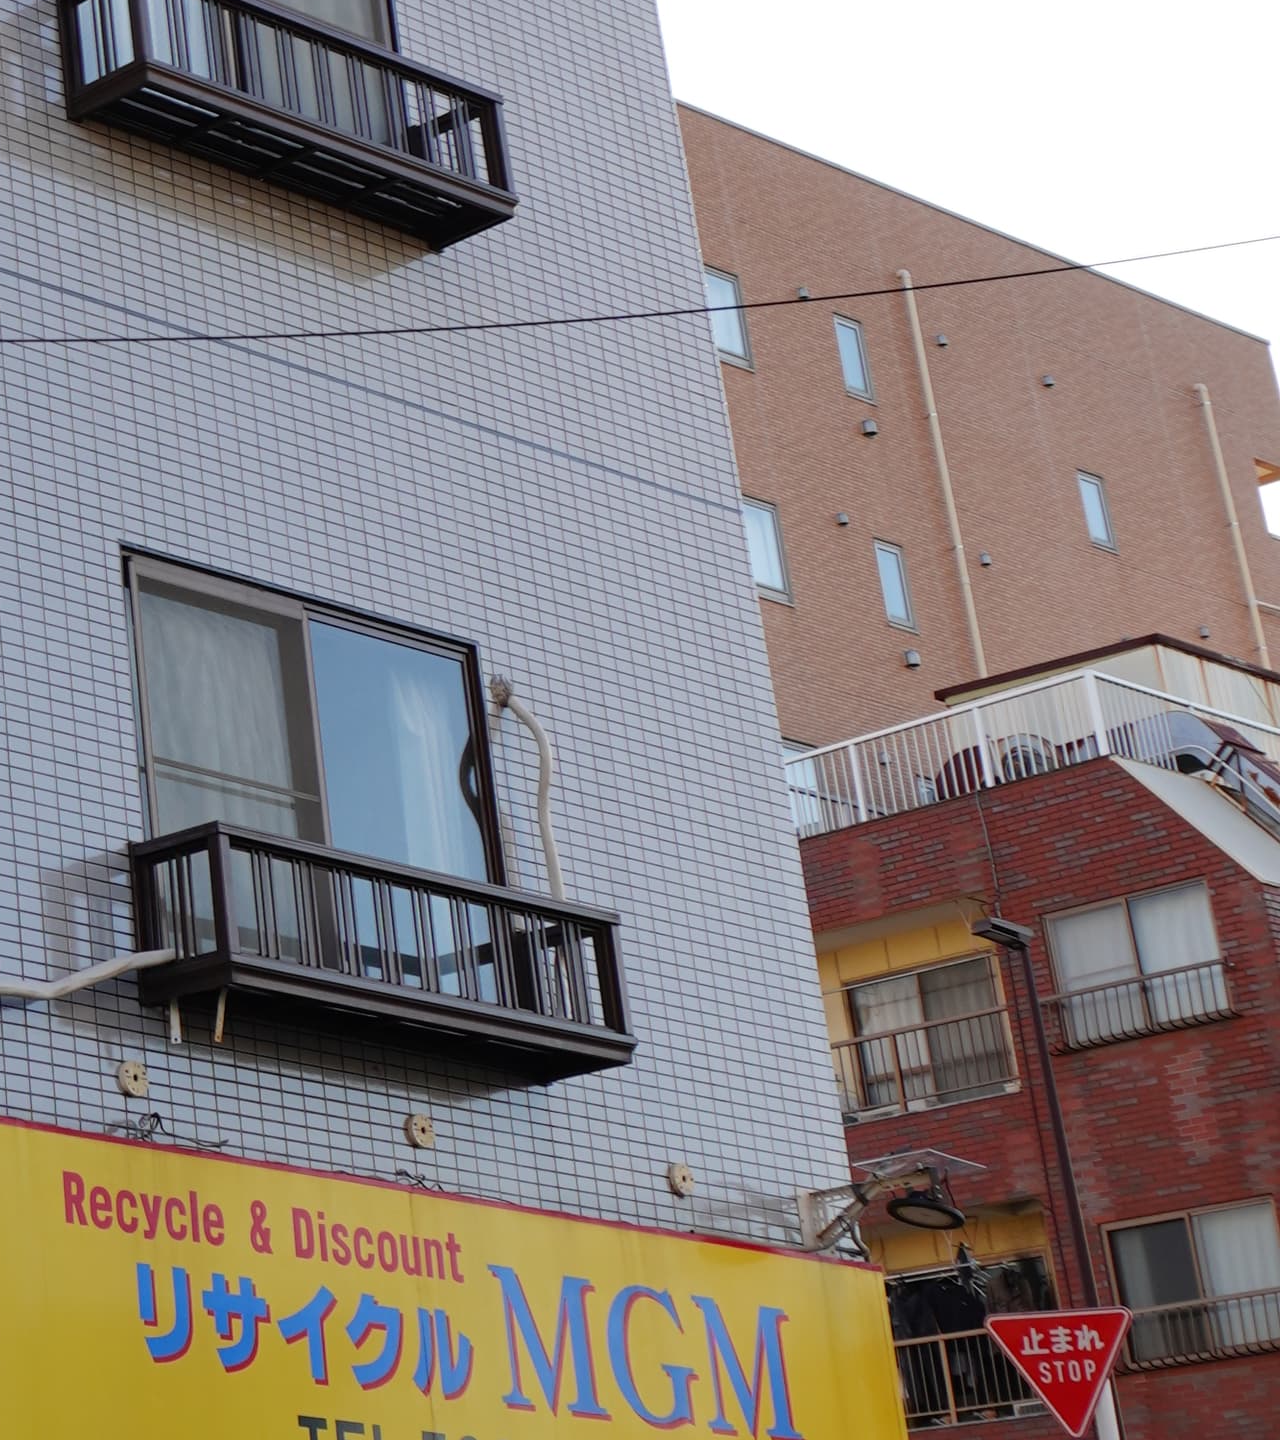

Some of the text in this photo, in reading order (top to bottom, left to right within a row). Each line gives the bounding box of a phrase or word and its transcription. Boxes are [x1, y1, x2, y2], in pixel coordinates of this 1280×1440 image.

[62, 1169, 465, 1284] Recycle & Discount
[137, 1264, 473, 1400] リサイクル
[1020, 1324, 1105, 1358] 止まれ
[1037, 1358, 1097, 1385] STOP
